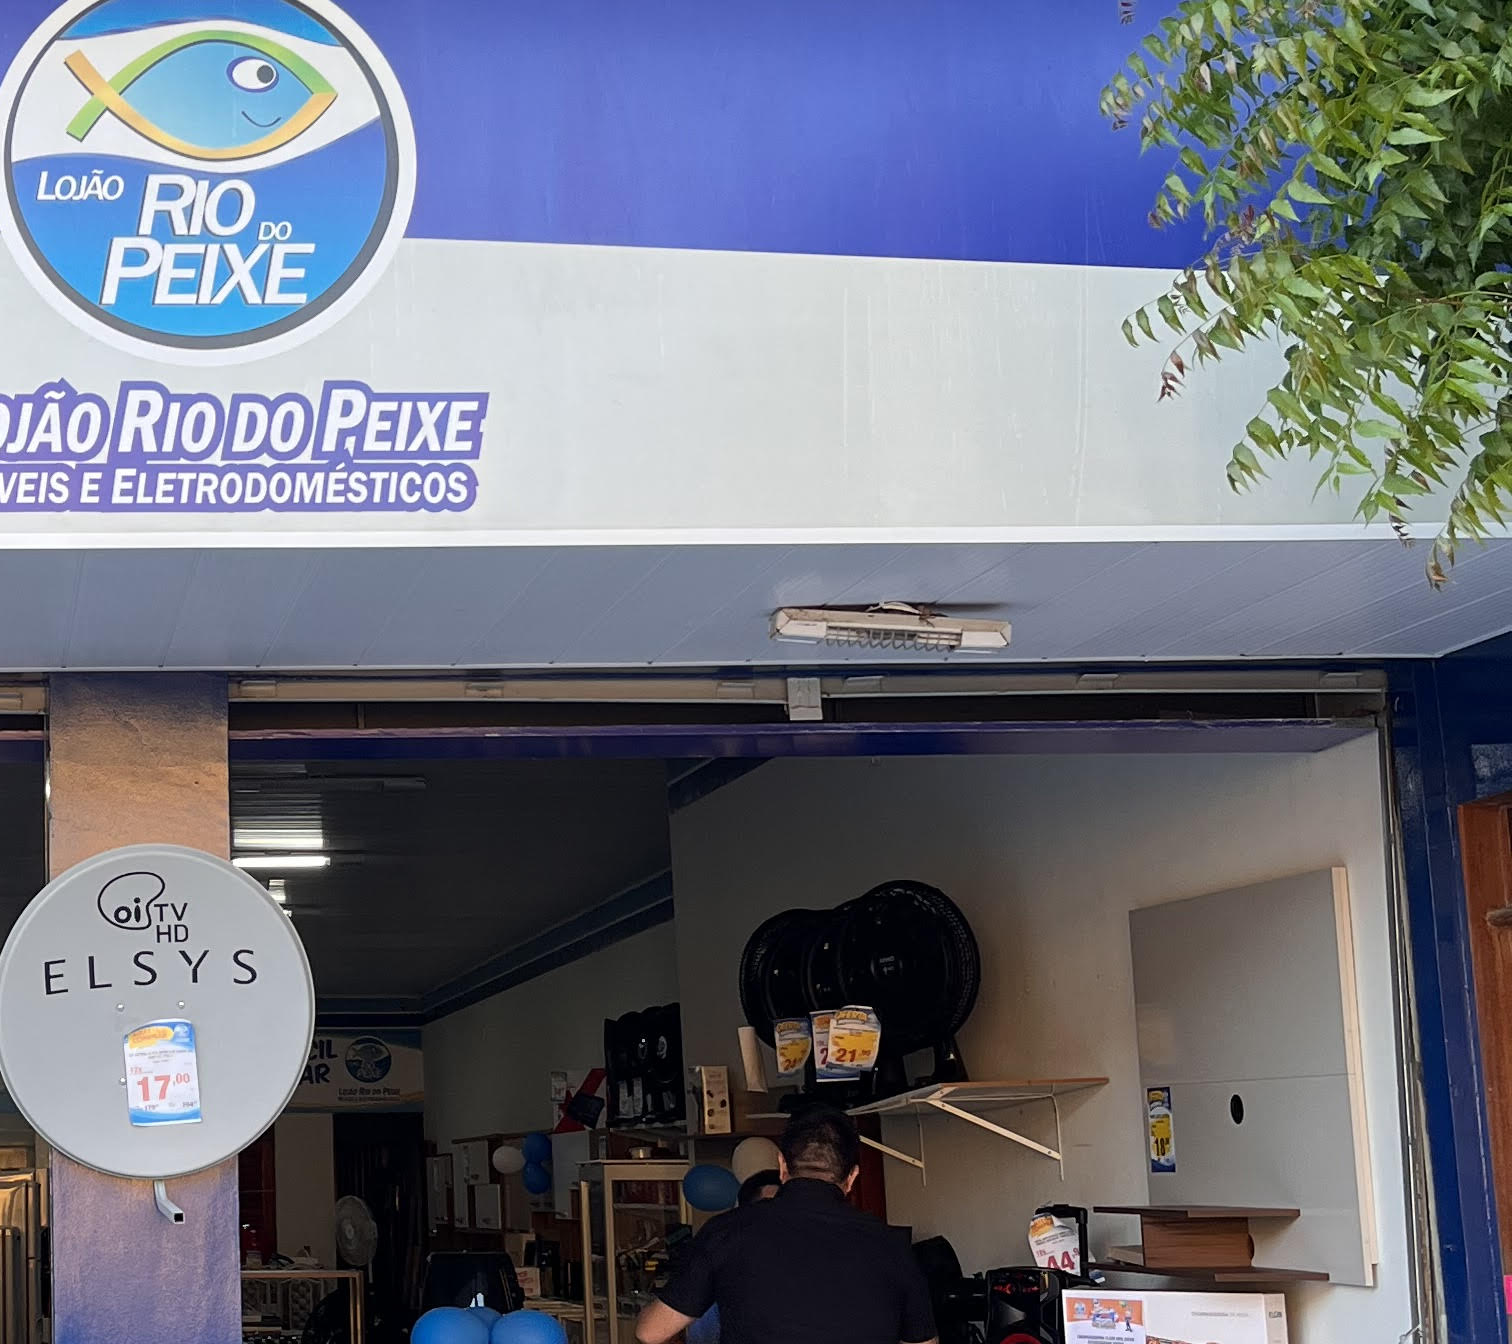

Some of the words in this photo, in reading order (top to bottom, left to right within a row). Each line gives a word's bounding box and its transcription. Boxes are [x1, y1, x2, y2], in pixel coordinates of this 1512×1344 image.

[36, 169, 124, 202] LOJÃO
[137, 173, 256, 237] RIO
[257, 221, 293, 242] DO
[99, 238, 315, 306] PEIXE
[119, 389, 217, 454] RIO
[225, 400, 312, 453] DO
[322, 389, 480, 454] PEIXE
[79, 472, 100, 505] E
[111, 463, 469, 505] ELETRODOMÉSTICOS
[153, 902, 189, 923] TV
[155, 924, 190, 944] HD
[43, 949, 258, 996] ELSYS
